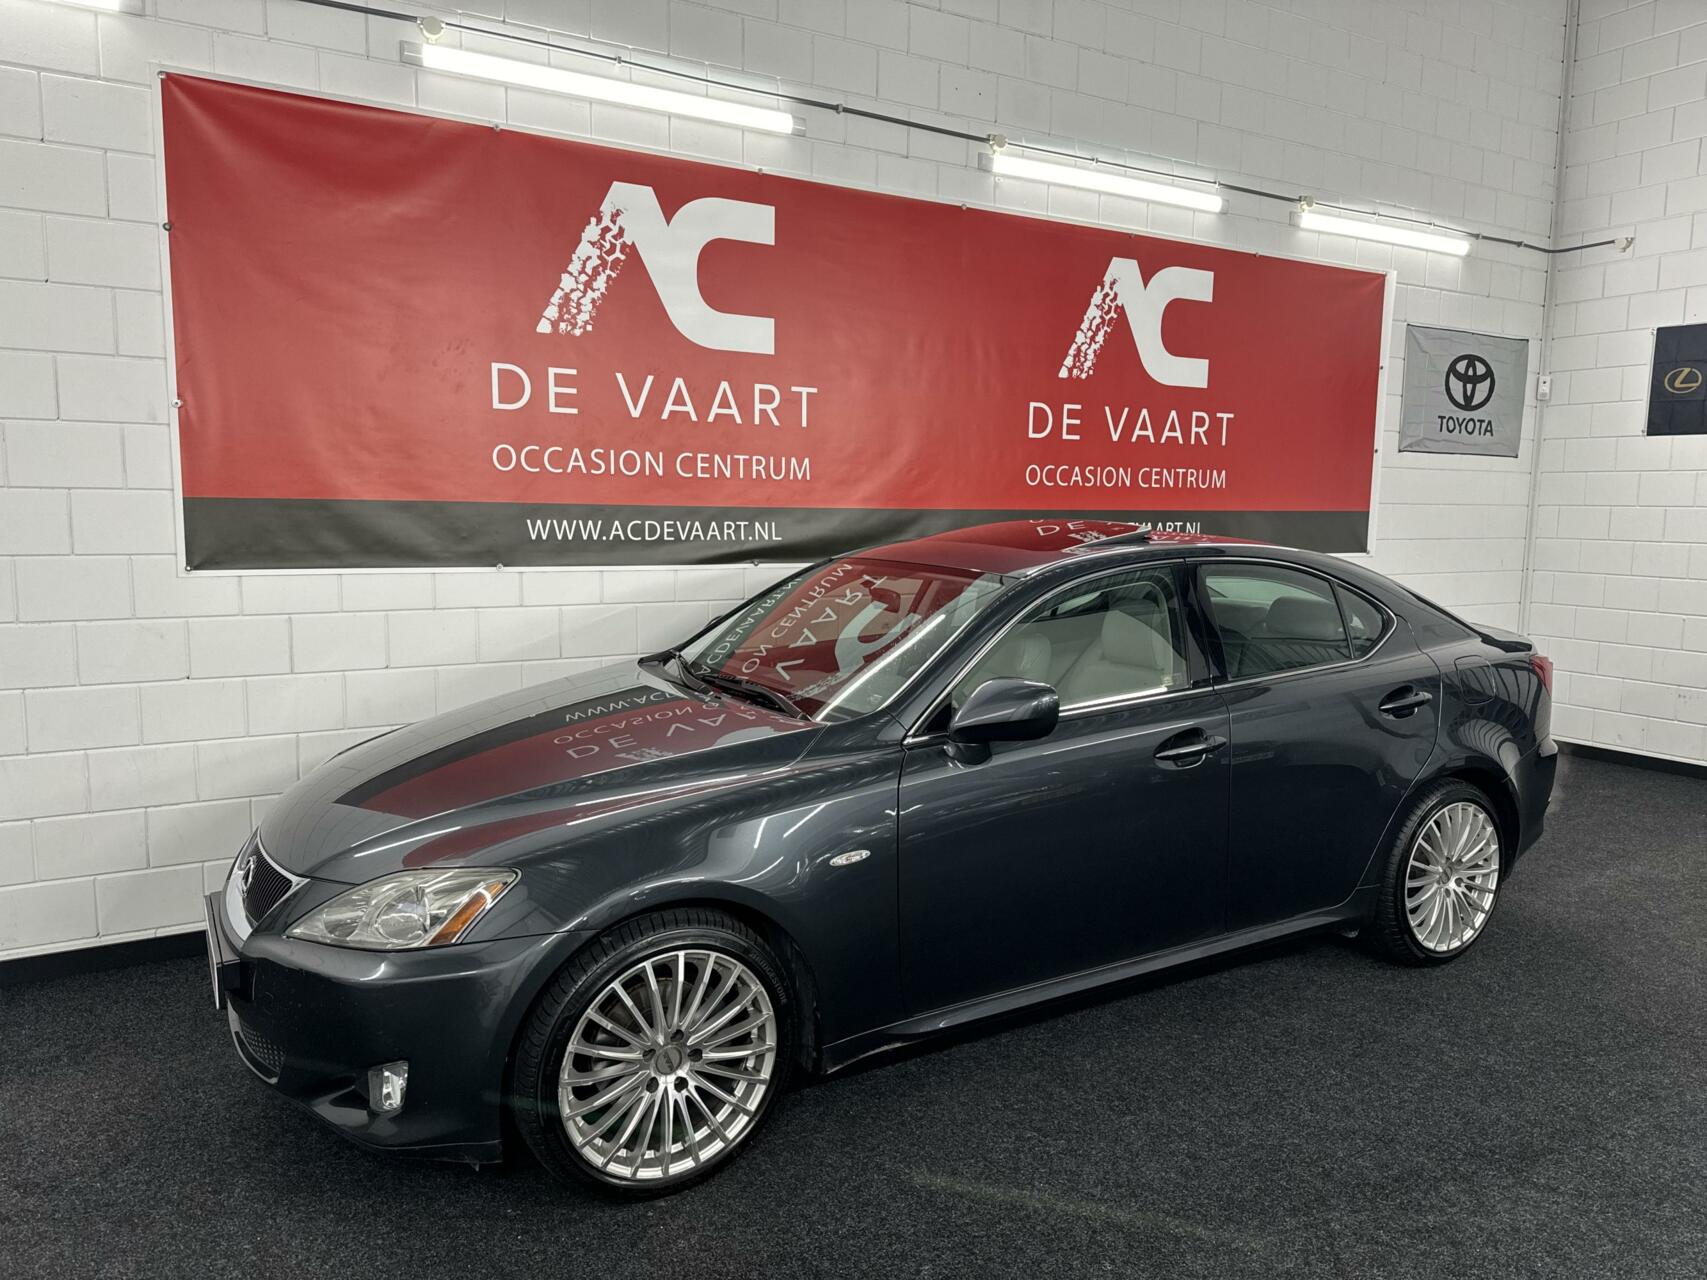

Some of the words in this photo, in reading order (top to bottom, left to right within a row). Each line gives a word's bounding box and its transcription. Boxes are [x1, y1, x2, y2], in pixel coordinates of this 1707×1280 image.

[536, 181, 775, 355] AC
[1058, 256, 1215, 389] AC
[491, 362, 578, 414] DE
[615, 372, 818, 428] VAART
[1028, 401, 1083, 440] DE
[1104, 406, 1235, 446] VAART
[1437, 415, 1494, 437] TOYOTA
[492, 444, 664, 477] OCCASION
[676, 452, 811, 481] CENTRUM
[1025, 464, 1132, 488] OCCASION
[1138, 467, 1227, 489] CENTRUM
[526, 519, 783, 541] WWW.ACDEVAART.NL
